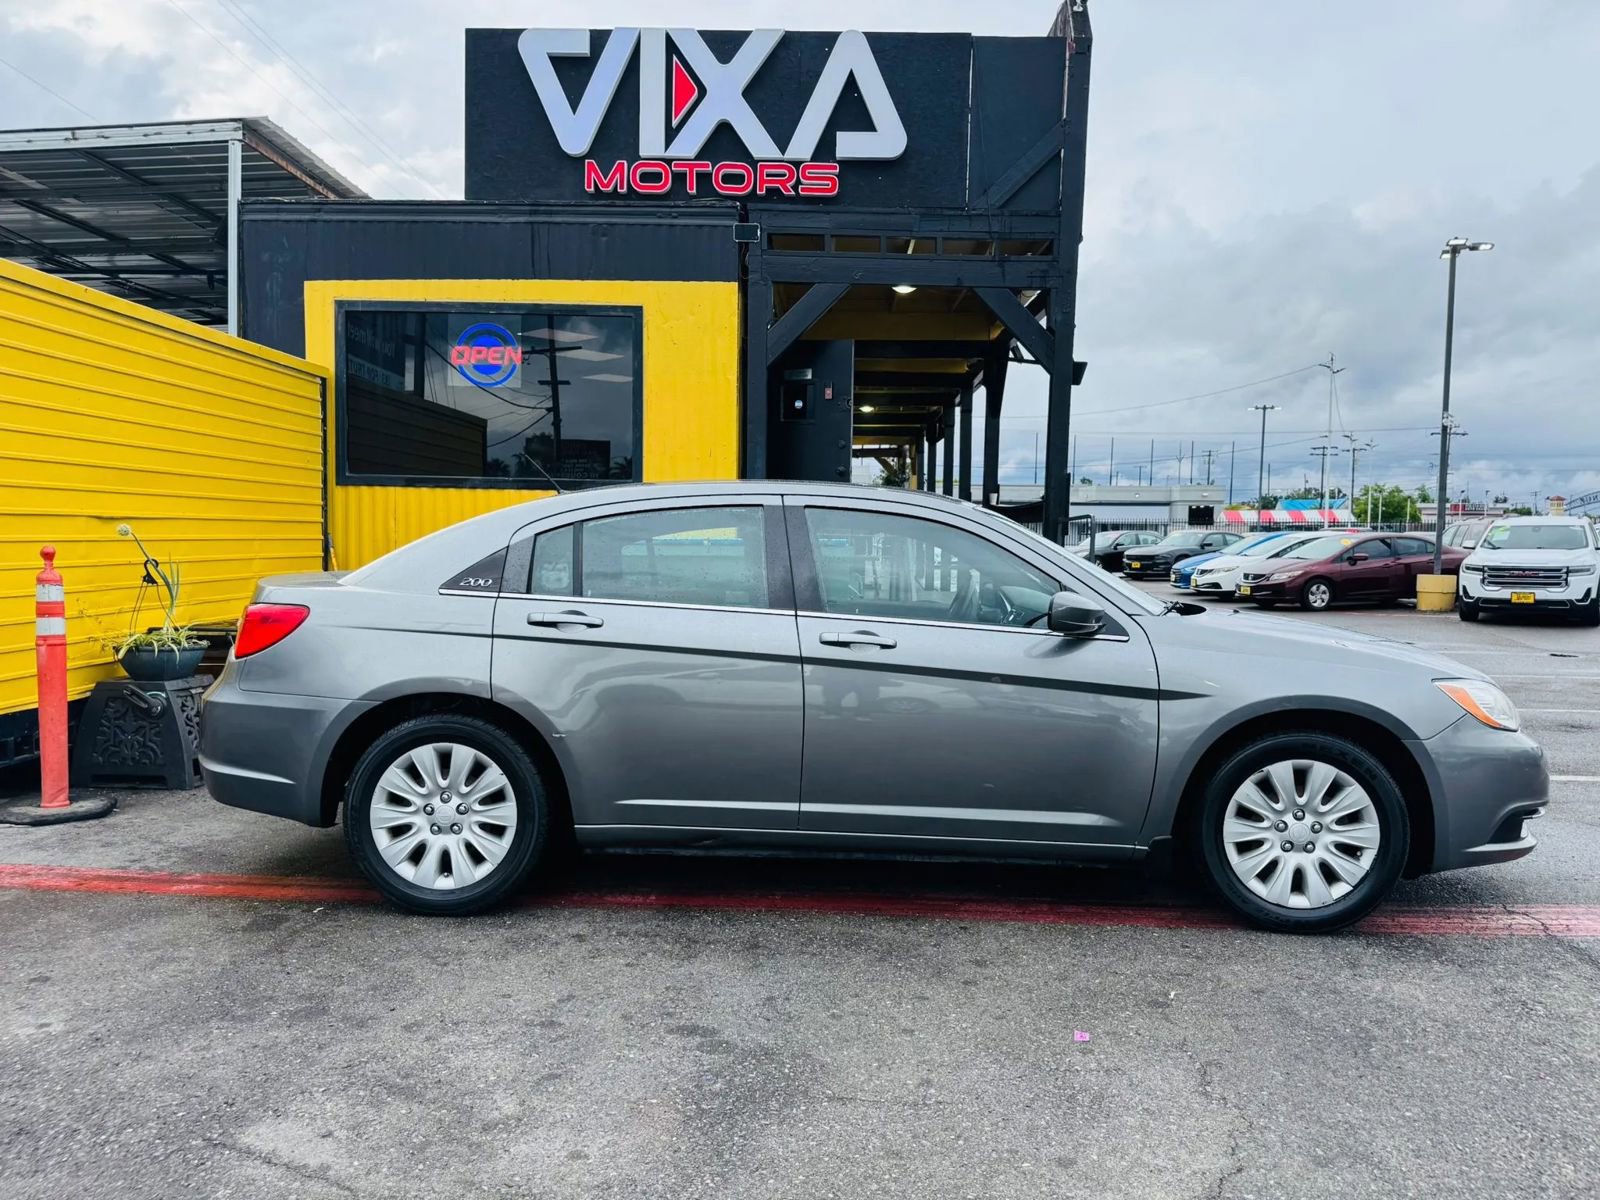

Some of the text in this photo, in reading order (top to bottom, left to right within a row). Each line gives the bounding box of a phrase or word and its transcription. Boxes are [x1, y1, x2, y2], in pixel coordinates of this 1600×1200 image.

[518, 27, 907, 161] VIXA
[584, 159, 840, 197] MOTORS
[451, 345, 522, 366] OPEN
[460, 577, 492, 587] 200
